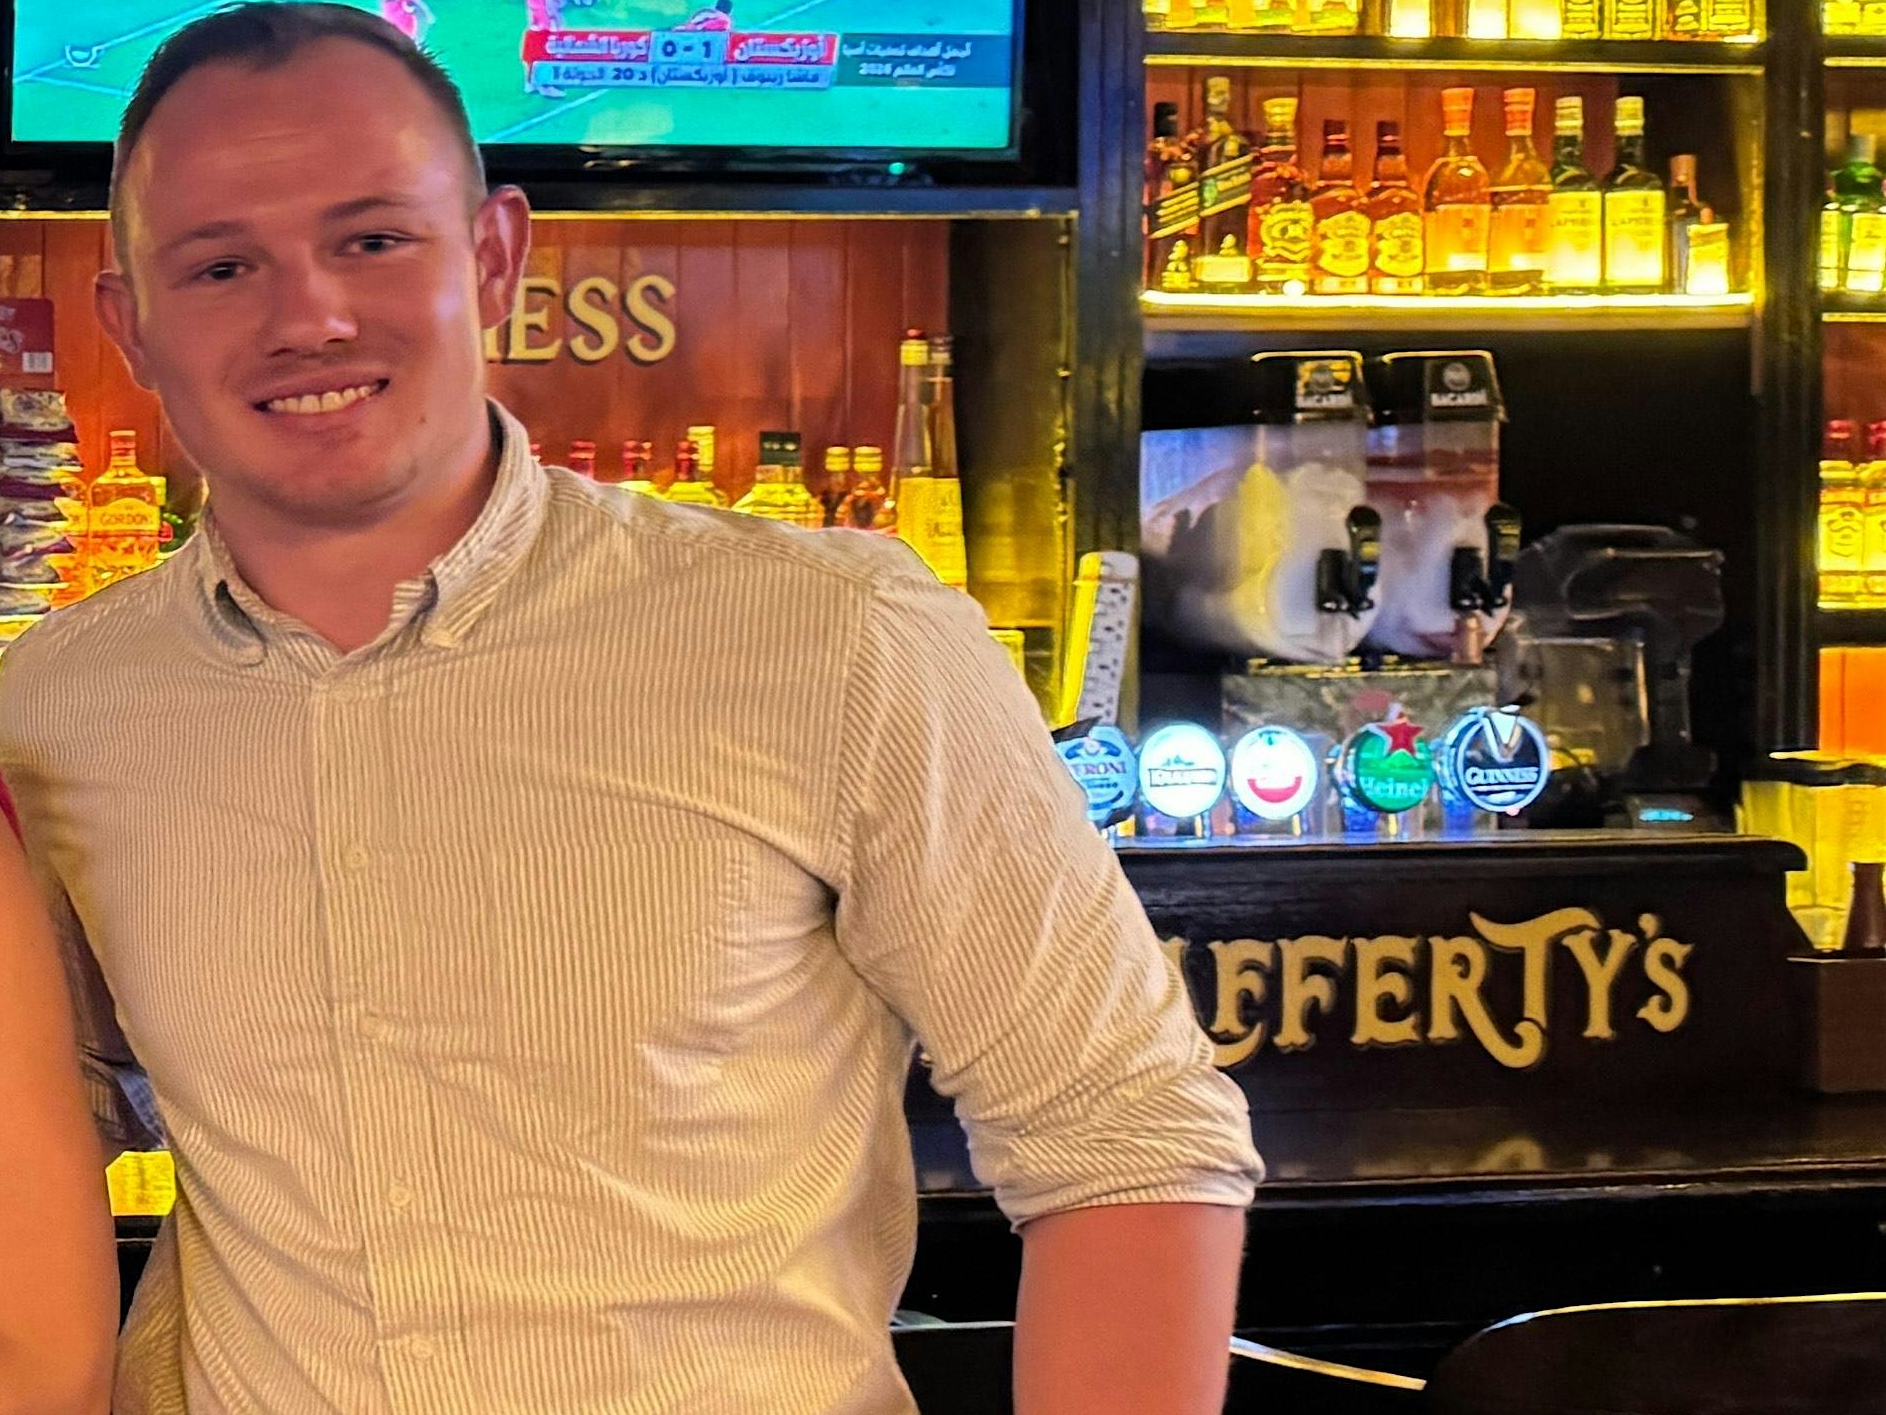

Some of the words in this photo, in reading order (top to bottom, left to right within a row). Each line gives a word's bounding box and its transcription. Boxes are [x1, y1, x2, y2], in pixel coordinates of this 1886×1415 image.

[662, 39, 677, 58] 0
[484, 274, 677, 365] ESS
[1465, 766, 1539, 786] GUINNESS
[1163, 906, 1693, 1069] FFERTY'S
